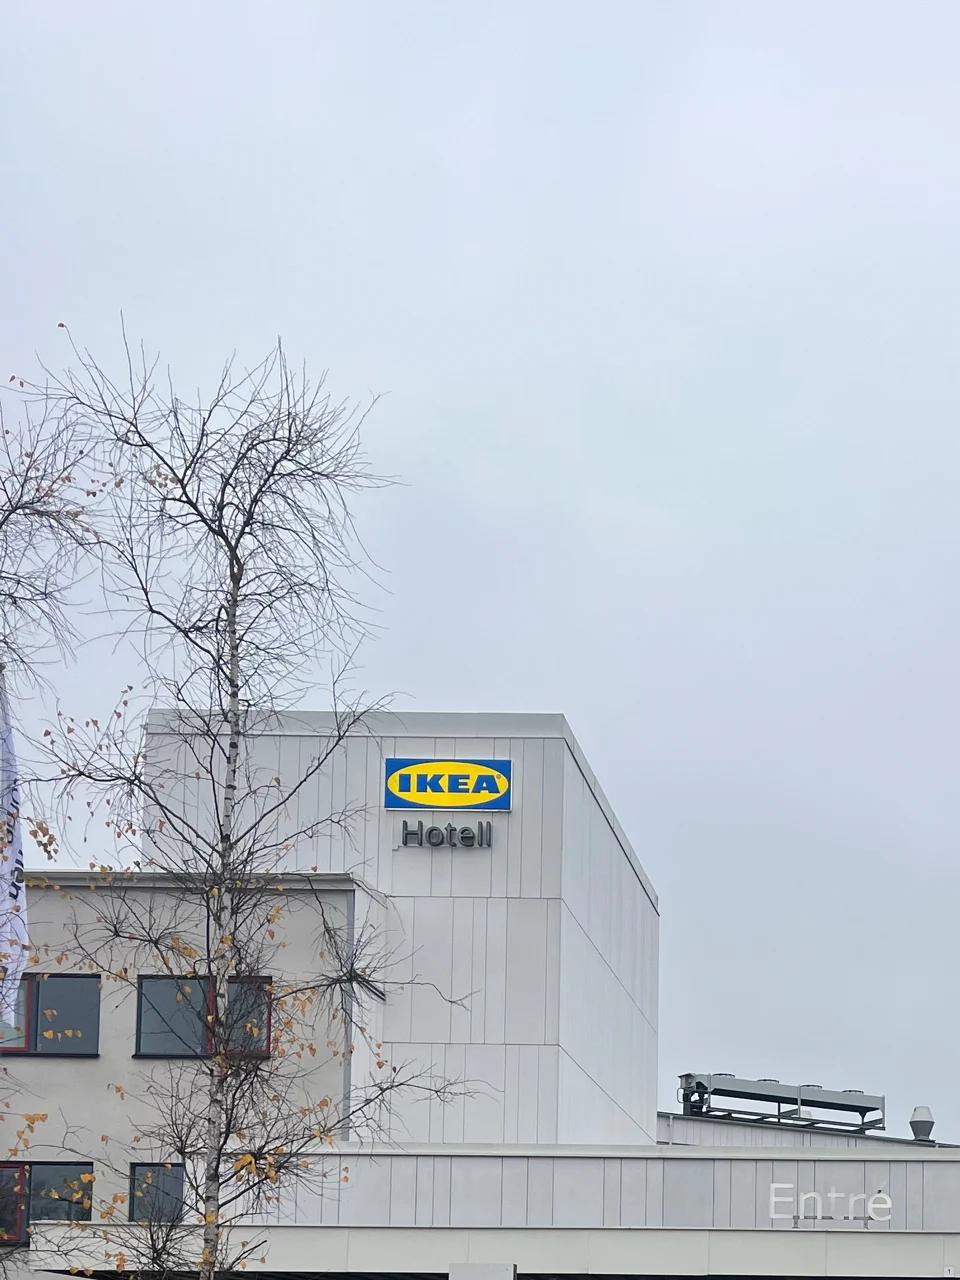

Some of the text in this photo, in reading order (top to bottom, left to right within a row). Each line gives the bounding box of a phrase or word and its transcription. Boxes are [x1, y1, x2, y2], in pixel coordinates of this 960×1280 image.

[398, 773, 501, 794] IKEA
[402, 820, 492, 848] Hotell
[769, 1181, 893, 1221] Entré
